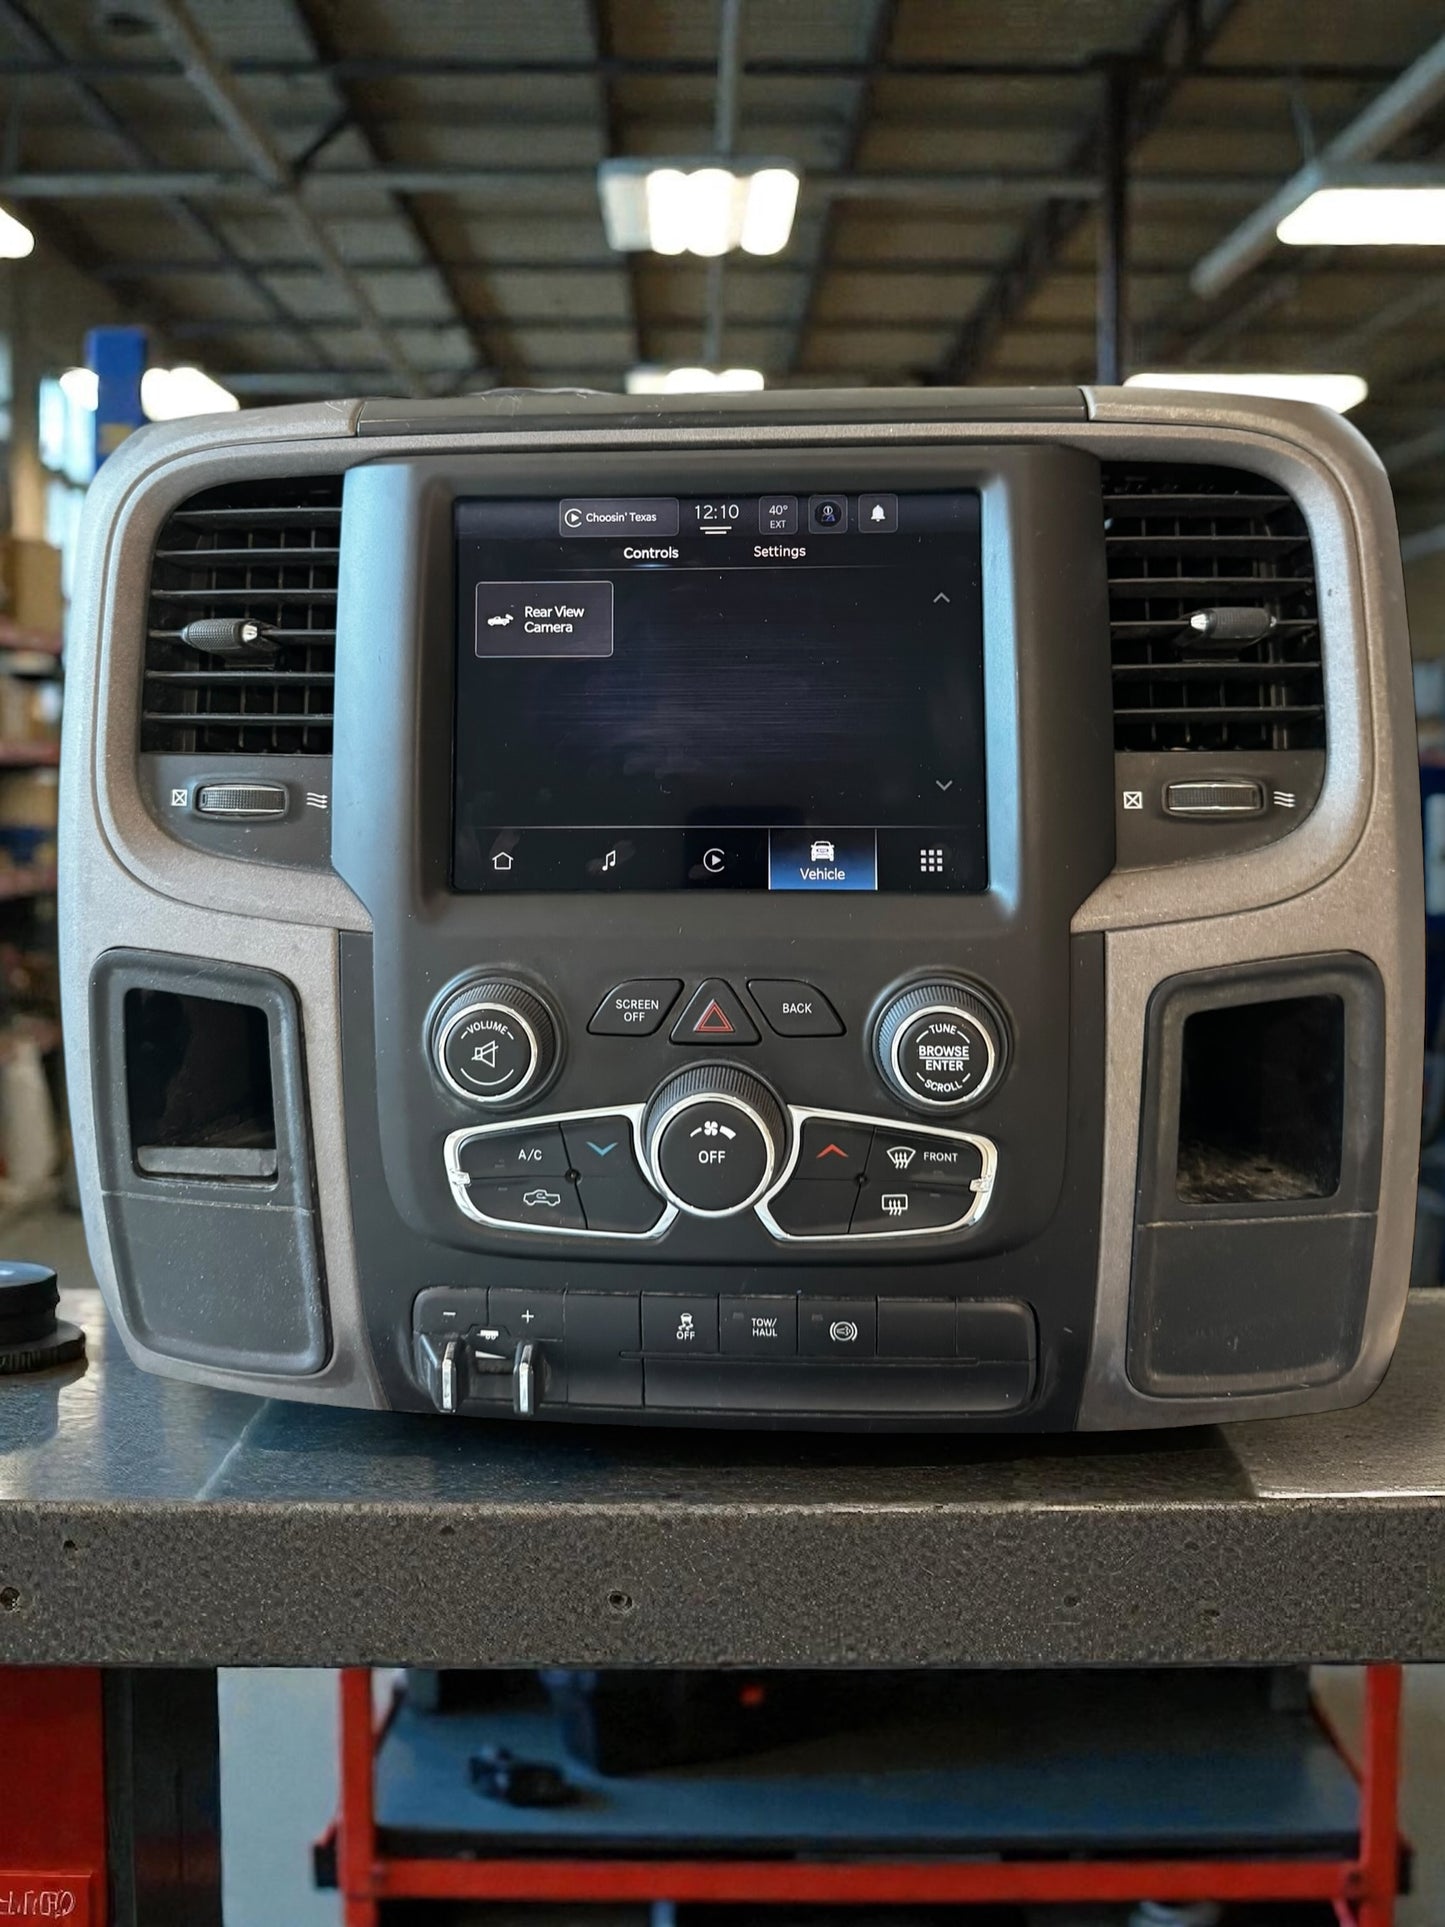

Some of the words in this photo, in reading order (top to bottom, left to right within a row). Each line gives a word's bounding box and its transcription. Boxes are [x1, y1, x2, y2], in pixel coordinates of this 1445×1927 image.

[586, 512, 628, 523] Choosin'
[630, 512, 657, 522] Texas
[695, 504, 740, 520] 12:10
[770, 520, 787, 529] EXT
[623, 546, 679, 559] Controls
[753, 545, 806, 559] Settings
[524, 605, 553, 618] Rear
[554, 605, 585, 618] View
[524, 621, 573, 633] Camera
[800, 867, 846, 880] Vehicle
[615, 999, 659, 1010] SCREEN
[782, 1003, 812, 1014] BACK
[623, 1012, 645, 1022] OFF
[466, 1020, 508, 1036] VOLUME
[929, 1023, 957, 1035] TUNE
[918, 1045, 969, 1057] BROWSE
[925, 1060, 964, 1071] ENTER
[924, 1079, 963, 1093] SCROLL
[517, 1148, 543, 1161] A/C
[698, 1150, 726, 1165] OFF
[923, 1151, 958, 1163] FRONT
[751, 1317, 777, 1328] TOW/
[676, 1330, 695, 1341] OFF
[752, 1327, 778, 1337] HAUL
